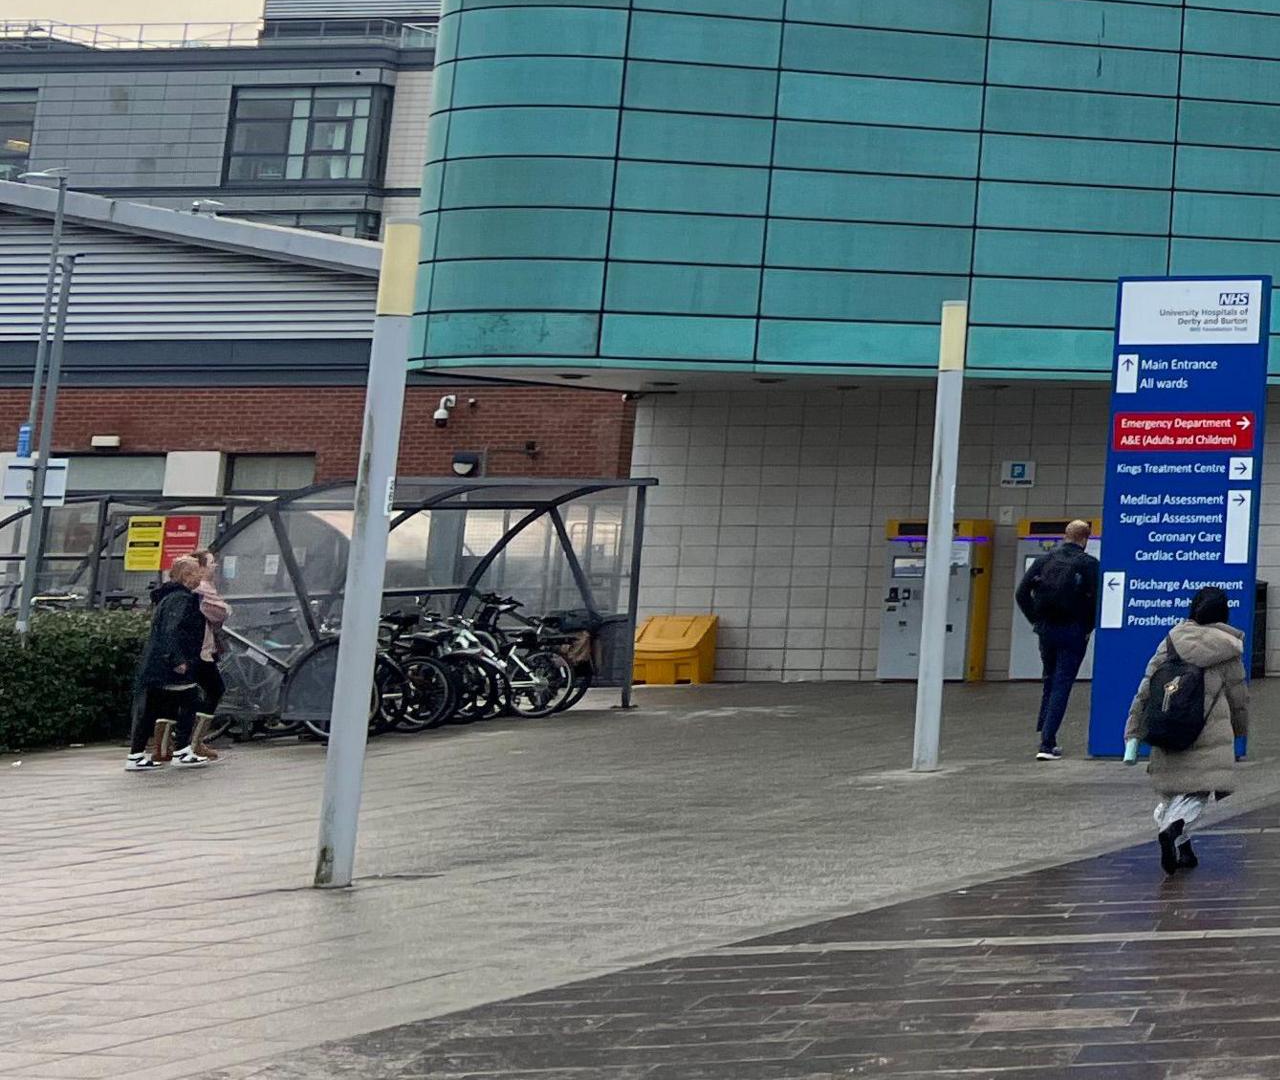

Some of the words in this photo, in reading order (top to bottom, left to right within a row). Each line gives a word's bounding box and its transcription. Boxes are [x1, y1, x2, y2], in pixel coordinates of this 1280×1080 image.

[1220, 293, 1248, 305] NHS
[1160, 309, 1198, 317] University
[1201, 309, 1237, 317] Hospitals
[1178, 318, 1201, 326] Derby
[1141, 359, 1168, 370] Main
[1171, 359, 1218, 370] Entrance
[1140, 378, 1154, 388] All
[1156, 377, 1188, 389] wards
[1121, 418, 1172, 430] Emergency
[1174, 418, 1231, 429] Department
[1120, 435, 1140, 445] A&E
[1142, 435, 1174, 446] (Adults
[1176, 435, 1193, 445] and
[1195, 434, 1237, 446] Children)
[1117, 464, 1142, 475] Kings
[1144, 463, 1192, 473] Treatment
[1194, 463, 1225, 473] Centre
[1120, 495, 1161, 505] Medical
[1163, 495, 1224, 505] Assessment
[1120, 513, 1160, 526] Surgical
[1161, 513, 1222, 524] Assessment
[1148, 531, 1196, 544] Coronary
[1198, 531, 1222, 542] Care
[1135, 550, 1174, 560] Cardiac
[1176, 550, 1221, 561] Catheter
[1129, 579, 1180, 592] Discharge
[1128, 598, 1173, 608] Amputee
